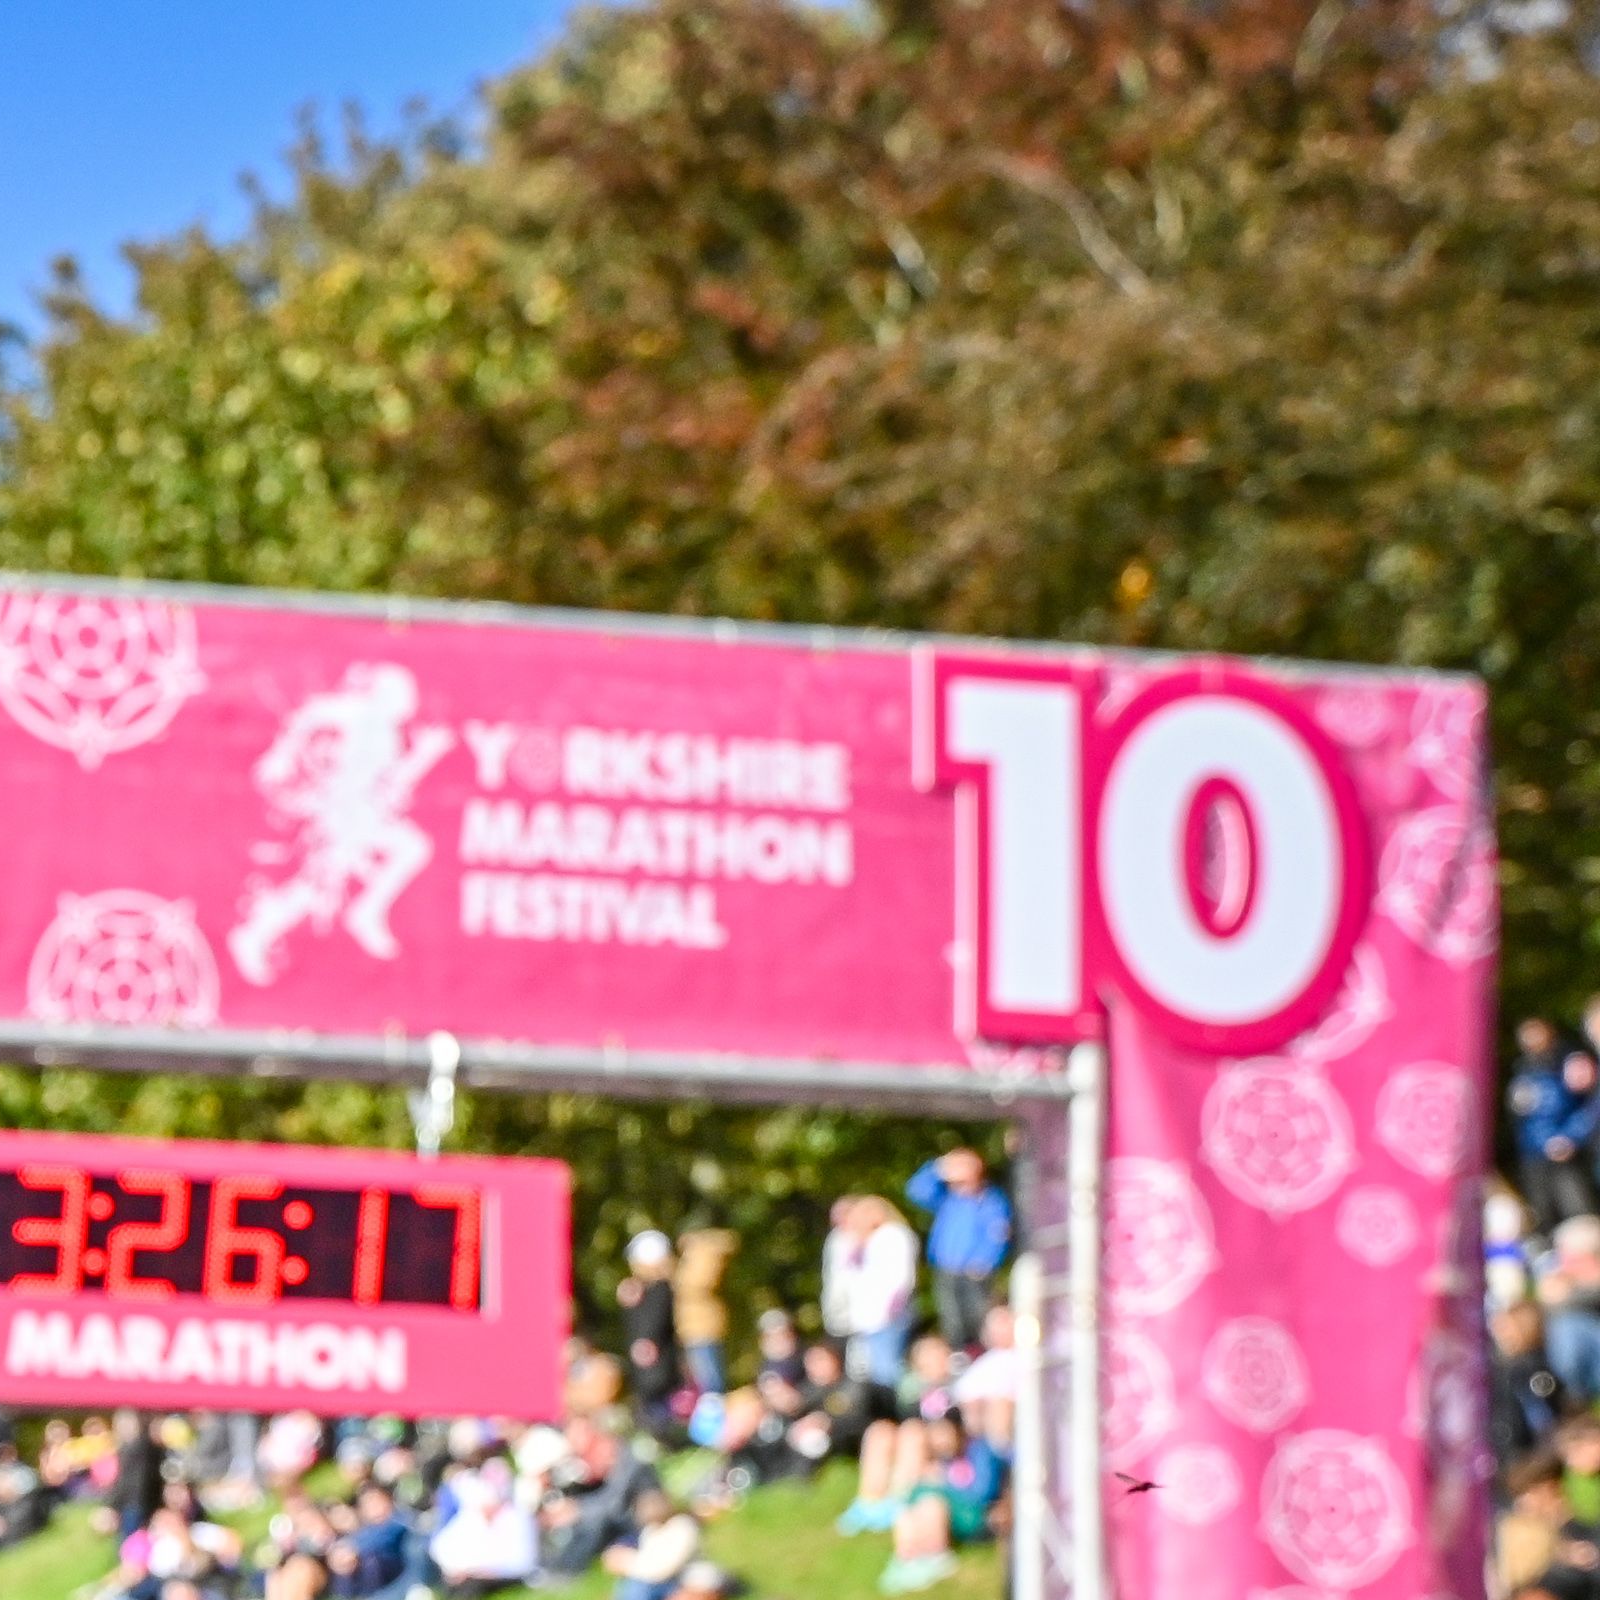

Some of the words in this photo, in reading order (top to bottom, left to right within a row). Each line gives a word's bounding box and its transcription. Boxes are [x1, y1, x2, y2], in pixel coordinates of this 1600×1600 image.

[459, 800, 853, 887] MARATHON
[945, 677, 1344, 1026] 10
[460, 871, 729, 948] FESTIVAL
[8, 1163, 482, 1312] 3:26:17
[6, 1311, 406, 1392] MARATHON
